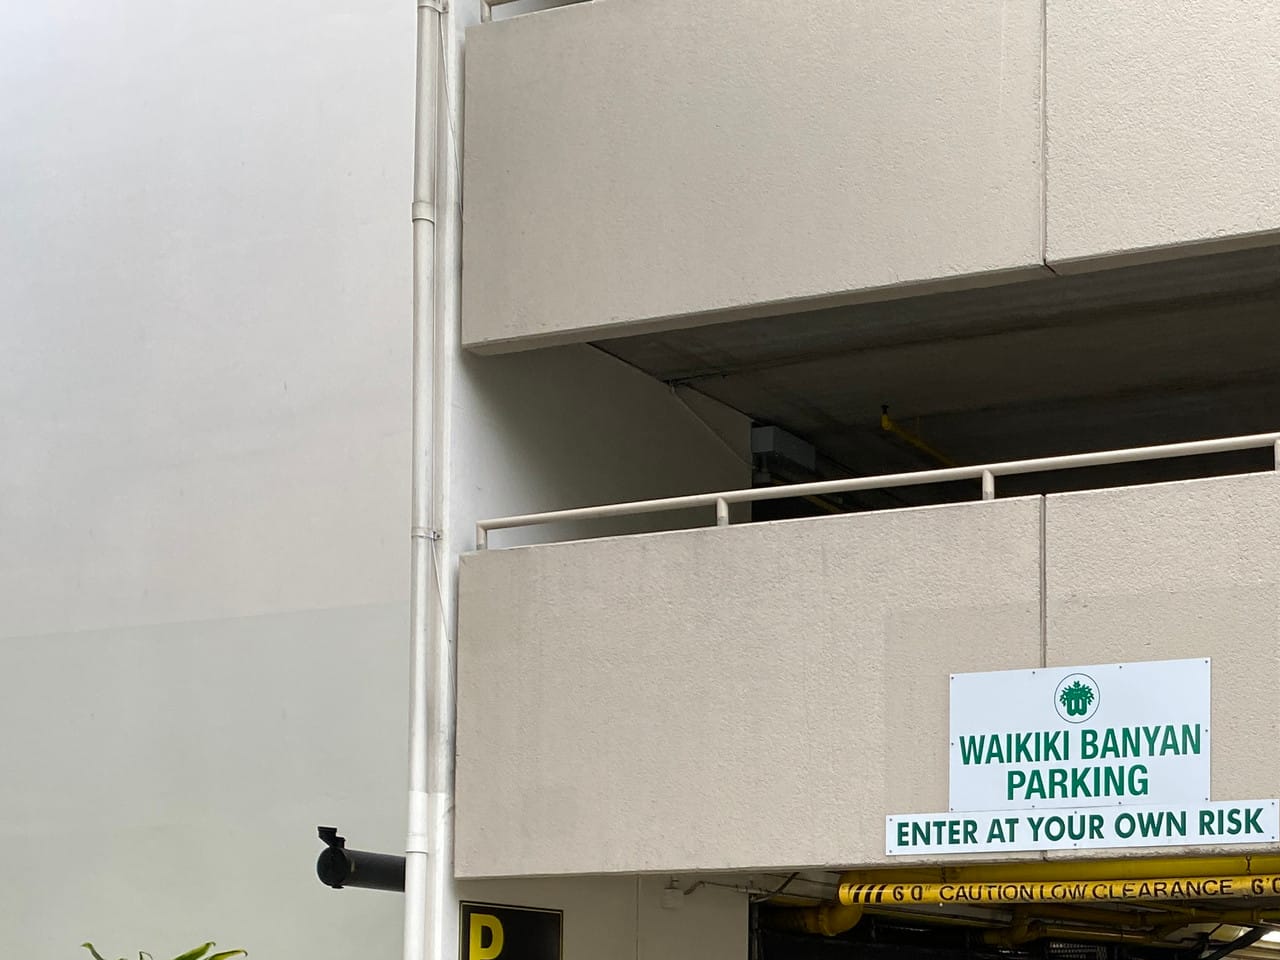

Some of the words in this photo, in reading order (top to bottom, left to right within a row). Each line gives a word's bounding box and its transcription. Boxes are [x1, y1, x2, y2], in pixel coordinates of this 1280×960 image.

[959, 730, 1070, 765] WAIKIKI
[1080, 723, 1201, 760] BANYAN
[1006, 764, 1149, 801] PARKING
[896, 819, 978, 846] ENTER
[987, 818, 1019, 843] AT
[1026, 813, 1105, 842] YOUR
[1114, 810, 1187, 838] OWN
[1199, 807, 1265, 836] RISK
[939, 884, 1034, 901] CAUTION
[1040, 884, 1086, 900] LOW
[1092, 879, 1234, 900] CLEARANCE
